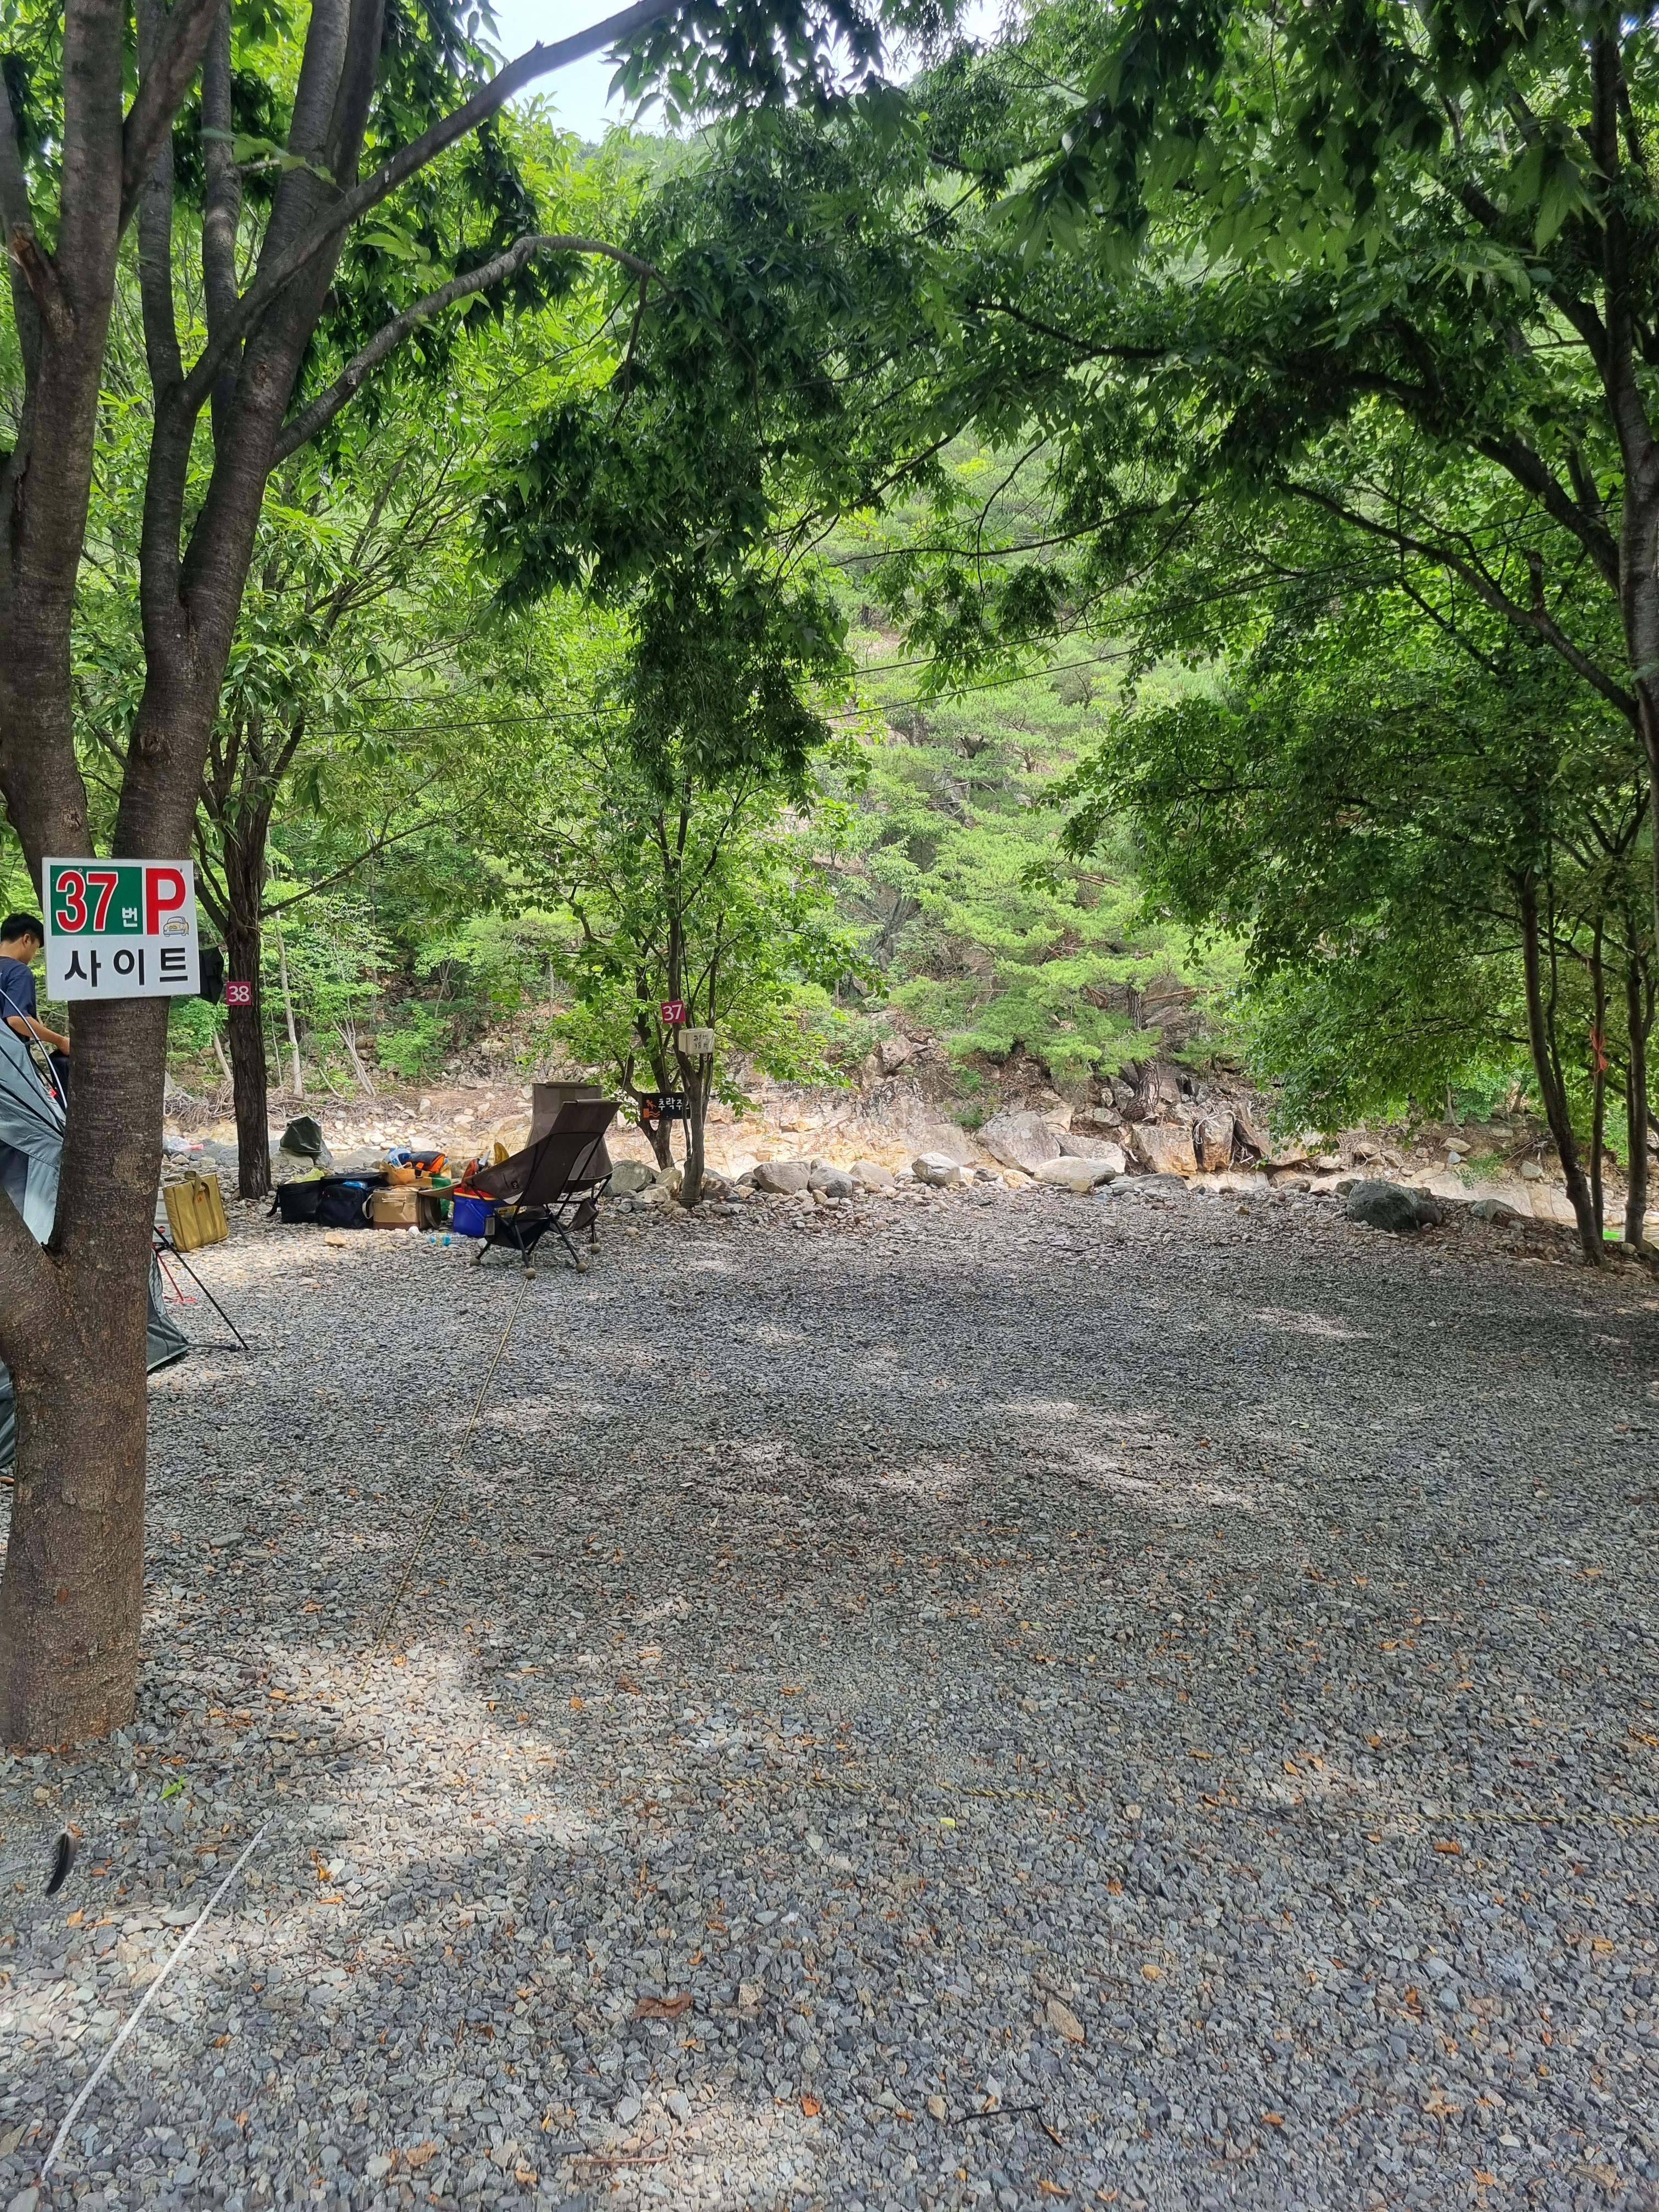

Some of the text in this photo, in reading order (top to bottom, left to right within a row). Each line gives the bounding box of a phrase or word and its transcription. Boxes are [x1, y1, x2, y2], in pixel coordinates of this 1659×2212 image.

[55, 868, 187, 935] 37번 P
[64, 947, 189, 988] 사이트
[228, 985, 250, 1002] 38
[663, 1004, 682, 1021] 37
